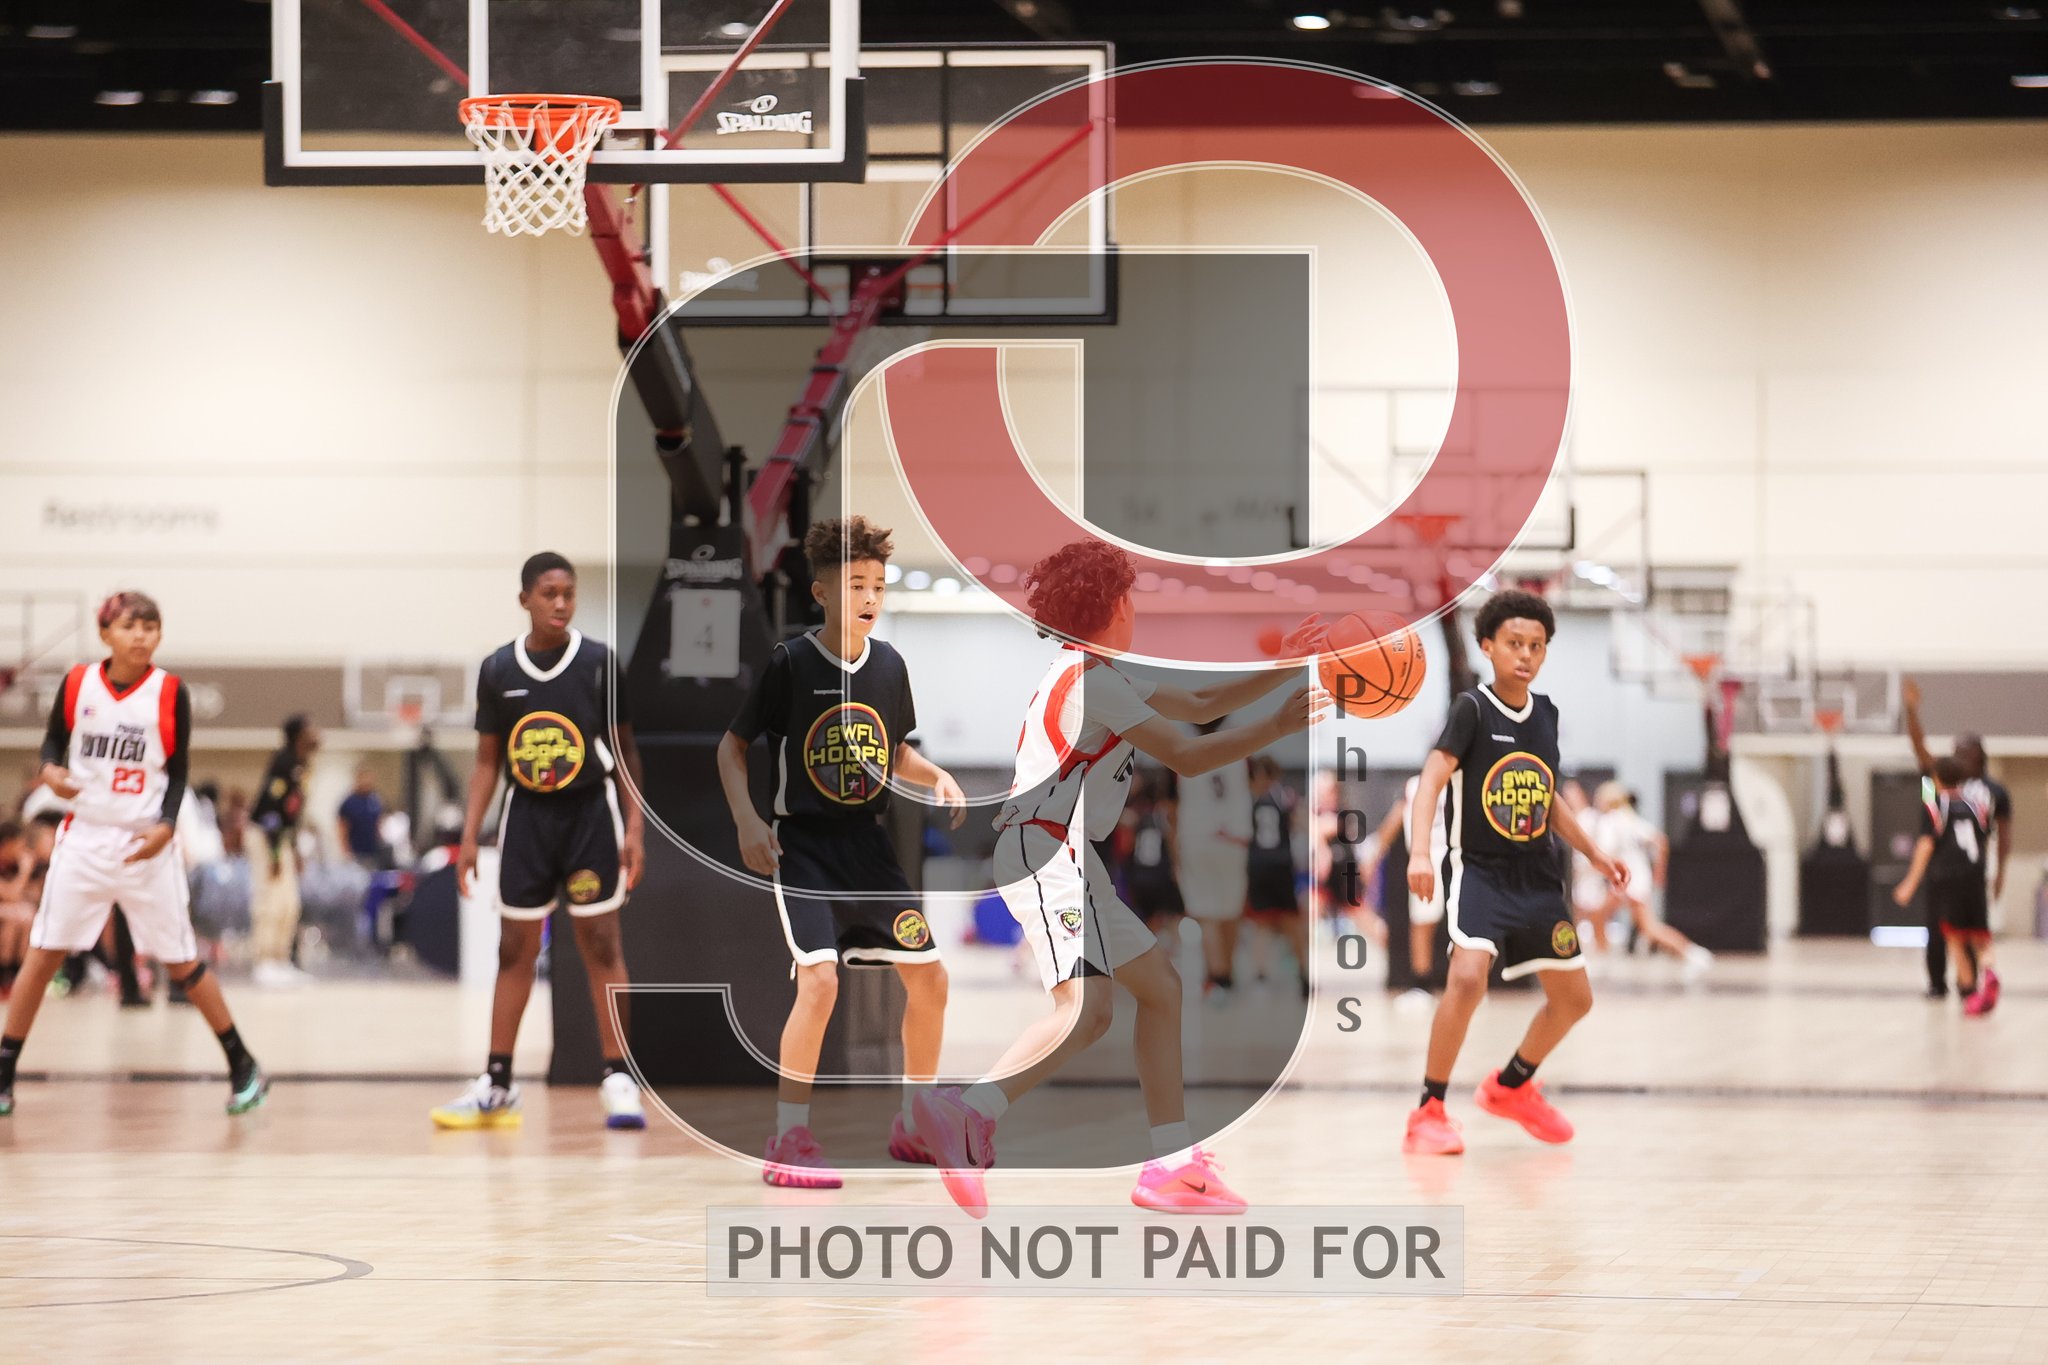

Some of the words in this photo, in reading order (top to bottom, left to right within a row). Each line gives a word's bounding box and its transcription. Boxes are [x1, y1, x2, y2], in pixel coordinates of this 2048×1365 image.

[716, 111, 814, 135] SPALDING
[826, 723, 879, 746] SWFL
[809, 745, 887, 767] HOOPS
[111, 766, 146, 795] 23
[1502, 769, 1547, 792] SWFL
